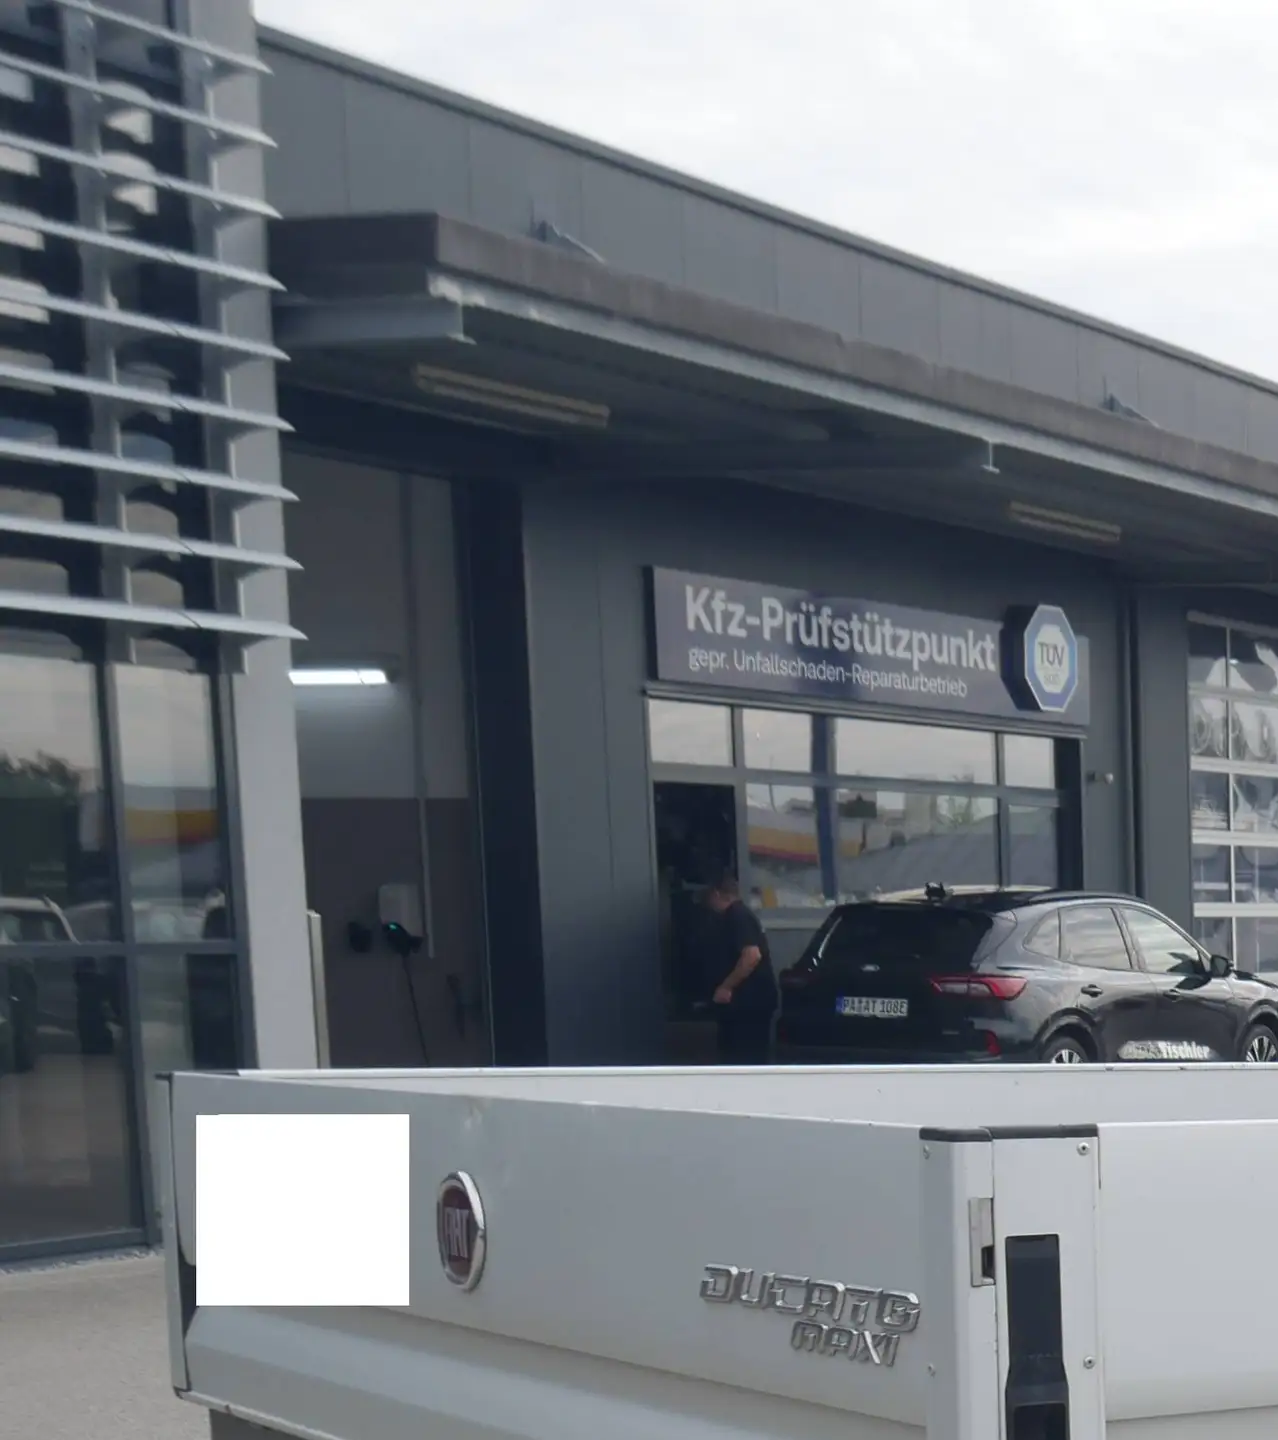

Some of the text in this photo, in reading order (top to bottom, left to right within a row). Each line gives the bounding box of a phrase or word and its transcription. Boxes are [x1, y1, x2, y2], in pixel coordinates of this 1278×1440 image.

[685, 584, 996, 672] Kfz-Prüfstützpunkt
[688, 648, 968, 698] gepr. Unfallschaden-Reparaturbetrieb
[700, 1263, 920, 1333] DUCATO
[790, 1319, 900, 1368] MAXI
